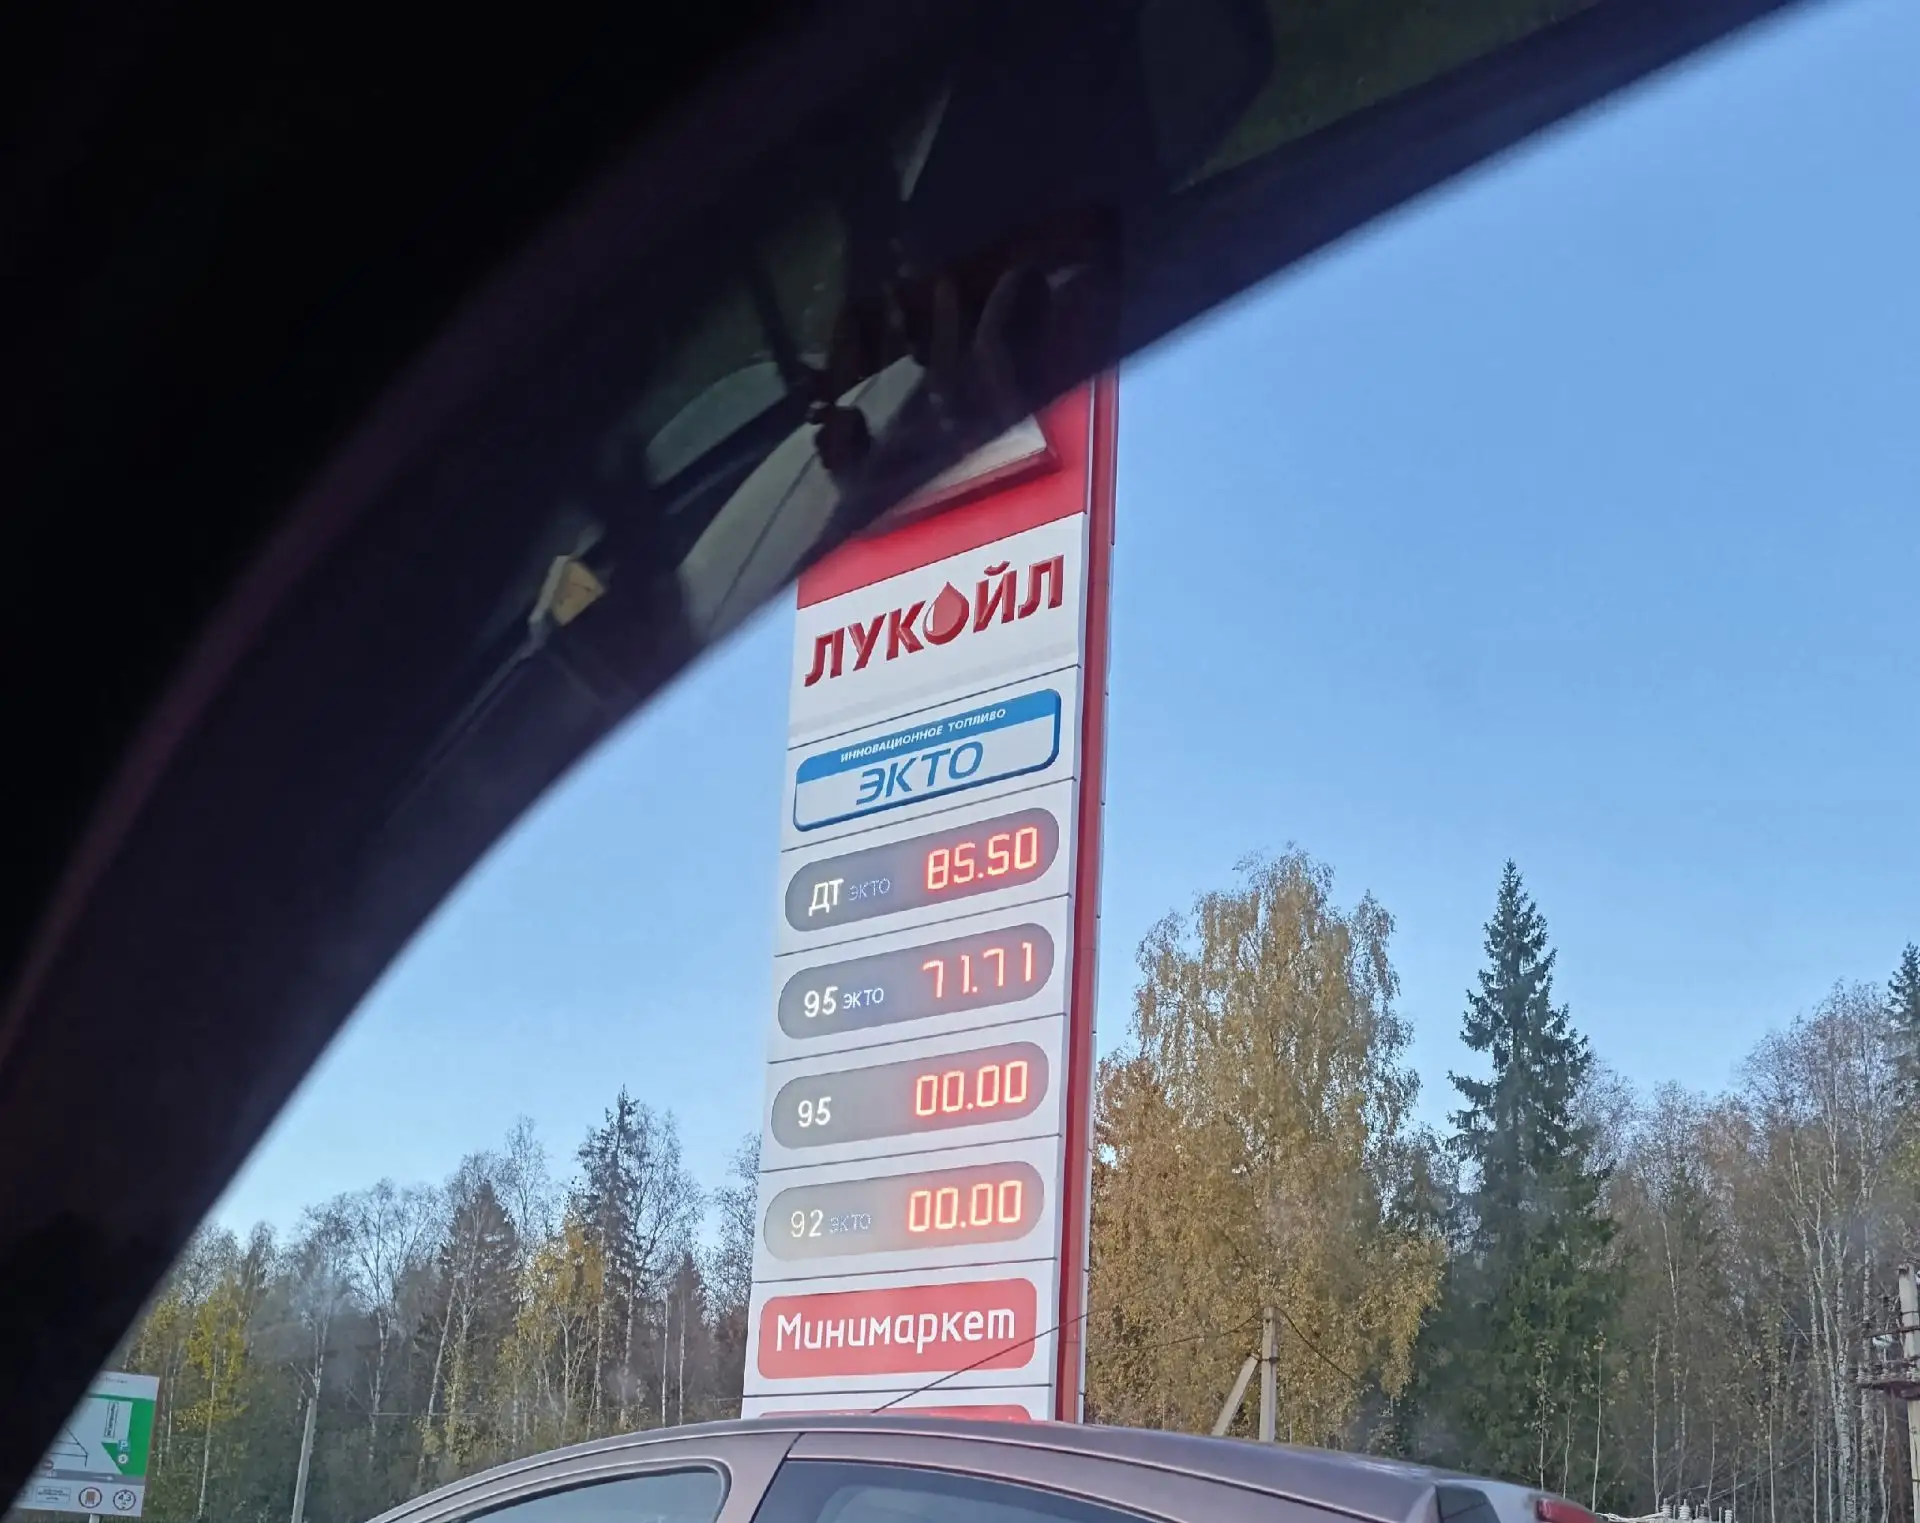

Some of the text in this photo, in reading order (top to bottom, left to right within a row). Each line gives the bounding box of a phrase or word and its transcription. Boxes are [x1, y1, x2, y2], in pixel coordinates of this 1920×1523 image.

[804, 555, 1064, 687] ЛУКОЙЛ
[840, 708, 1006, 763] ИННОВАЦИОННОЕ ТОПЛИВО
[856, 741, 984, 805] ЭКТО
[808, 826, 1038, 916] ДТ ЭКТО 85.50
[803, 942, 1033, 1018] 95 ЭКТО 71.71
[797, 1060, 1028, 1128] 95 00.00
[790, 1180, 1022, 1238] 92 ЭКТО 00.00
[776, 1307, 1015, 1354] Минимаркет
